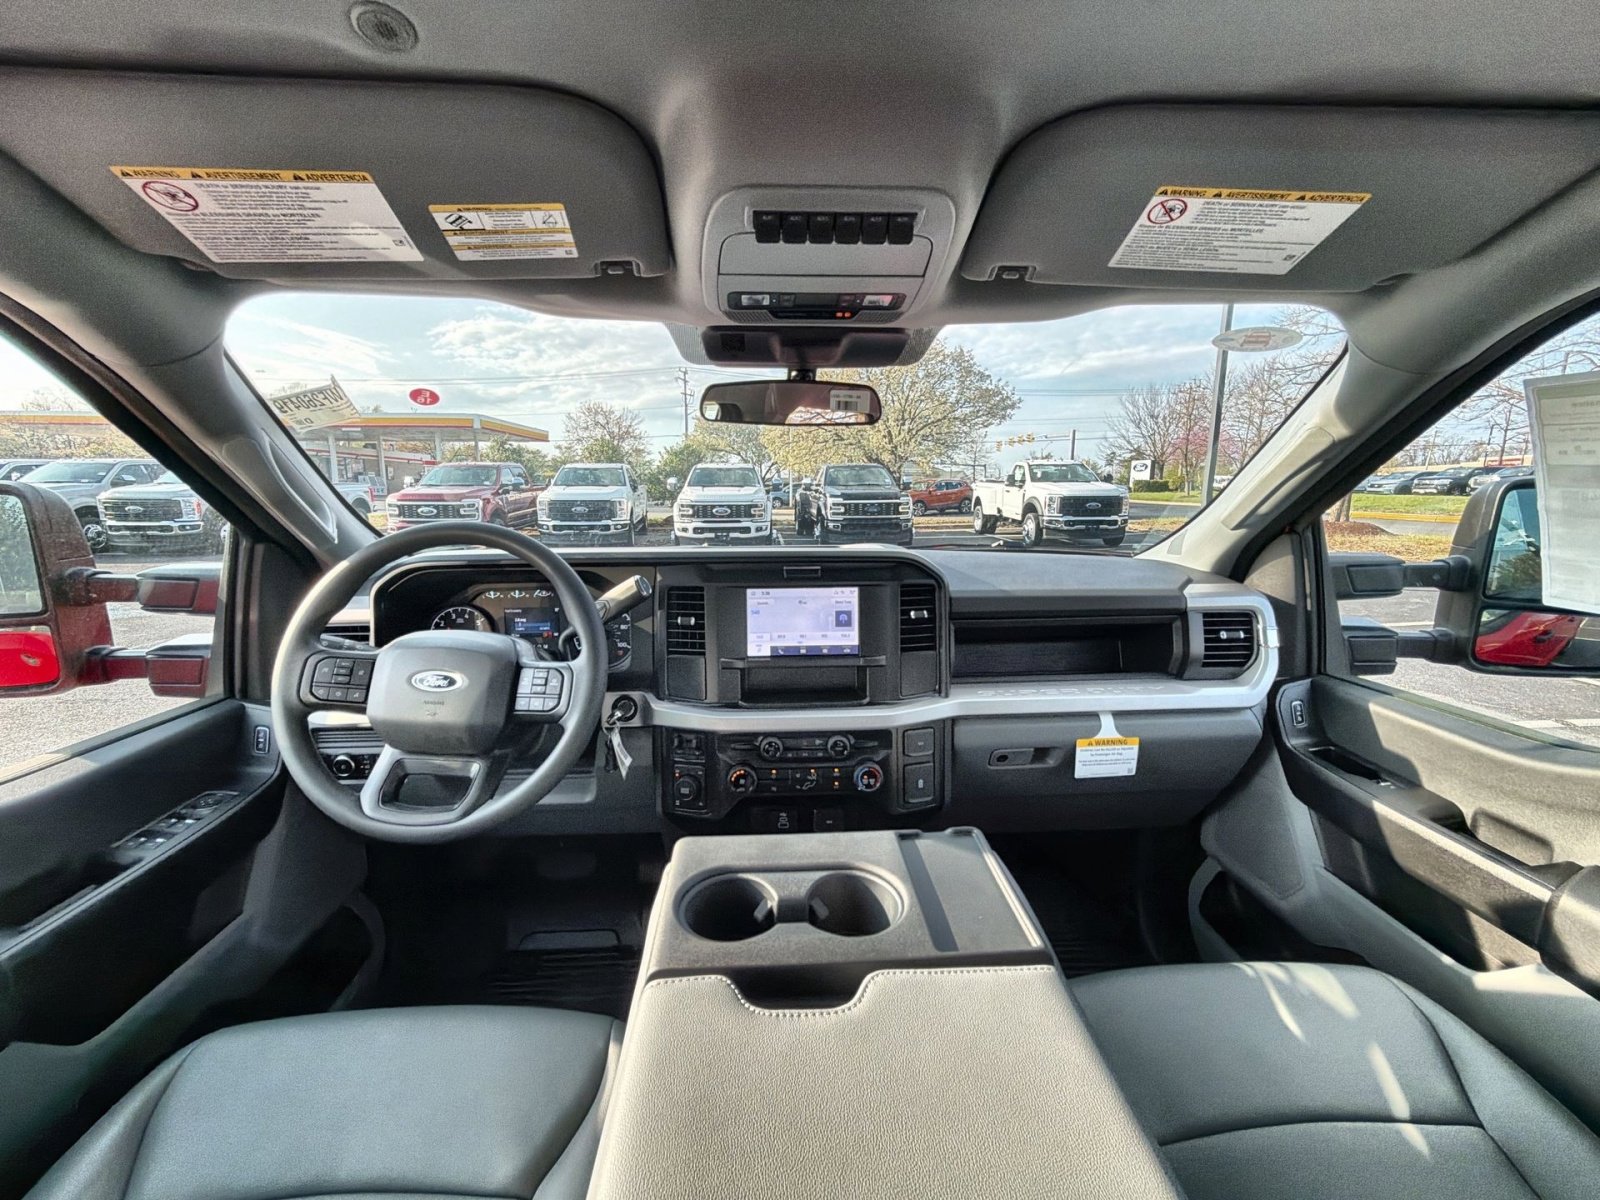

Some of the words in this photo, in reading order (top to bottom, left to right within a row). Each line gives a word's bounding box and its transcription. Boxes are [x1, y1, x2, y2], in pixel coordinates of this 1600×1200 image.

[204, 171, 283, 181] AVERTISSEMENT
[305, 173, 370, 182] ADVERTENCIA
[1169, 189, 1208, 197] WARNING
[1226, 191, 1292, 200] AVERTISSEMENT
